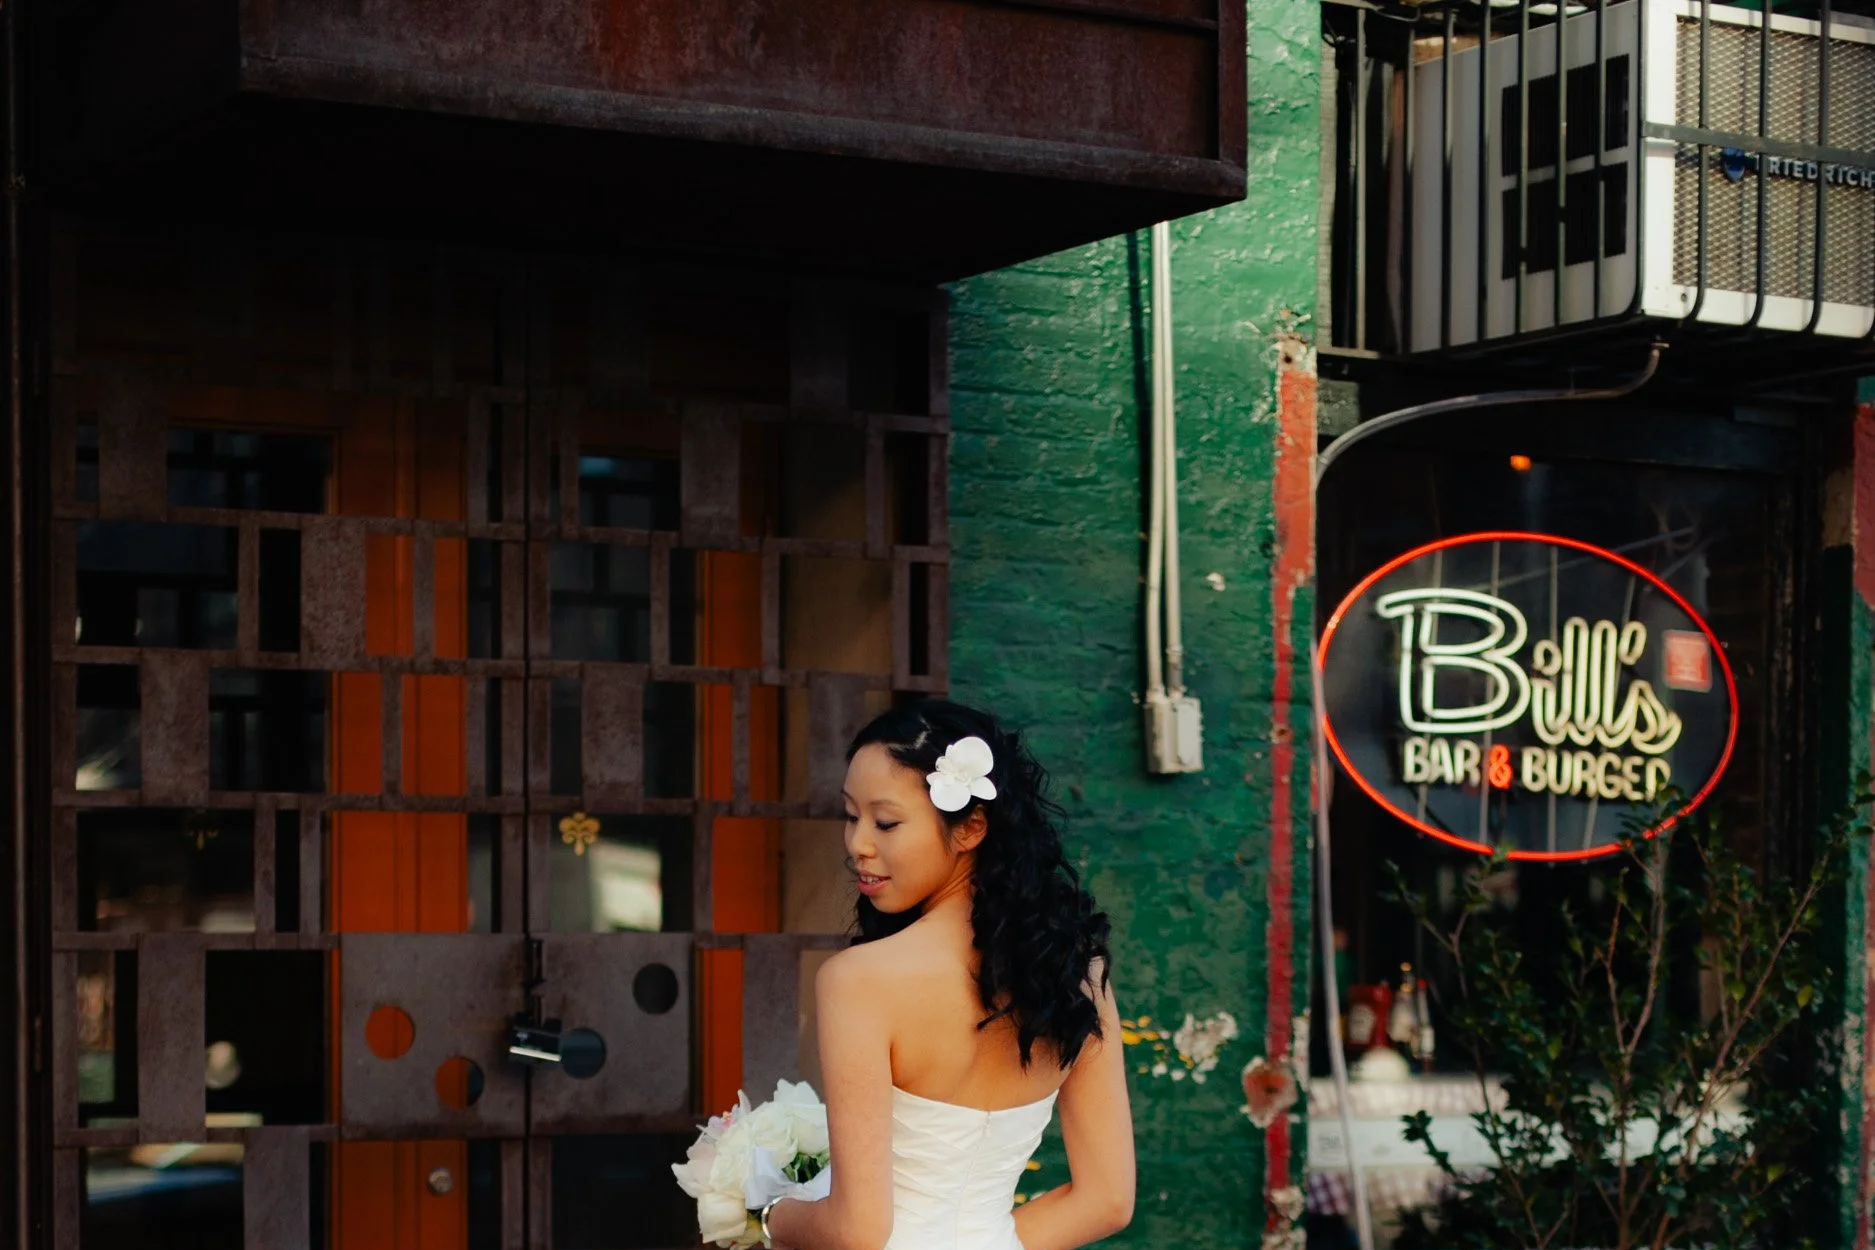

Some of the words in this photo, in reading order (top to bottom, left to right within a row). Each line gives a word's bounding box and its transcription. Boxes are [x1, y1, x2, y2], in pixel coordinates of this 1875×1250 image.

[1376, 587, 1682, 754] Bill's
[1404, 737, 1481, 785] BAR
[1489, 744, 1513, 789] &
